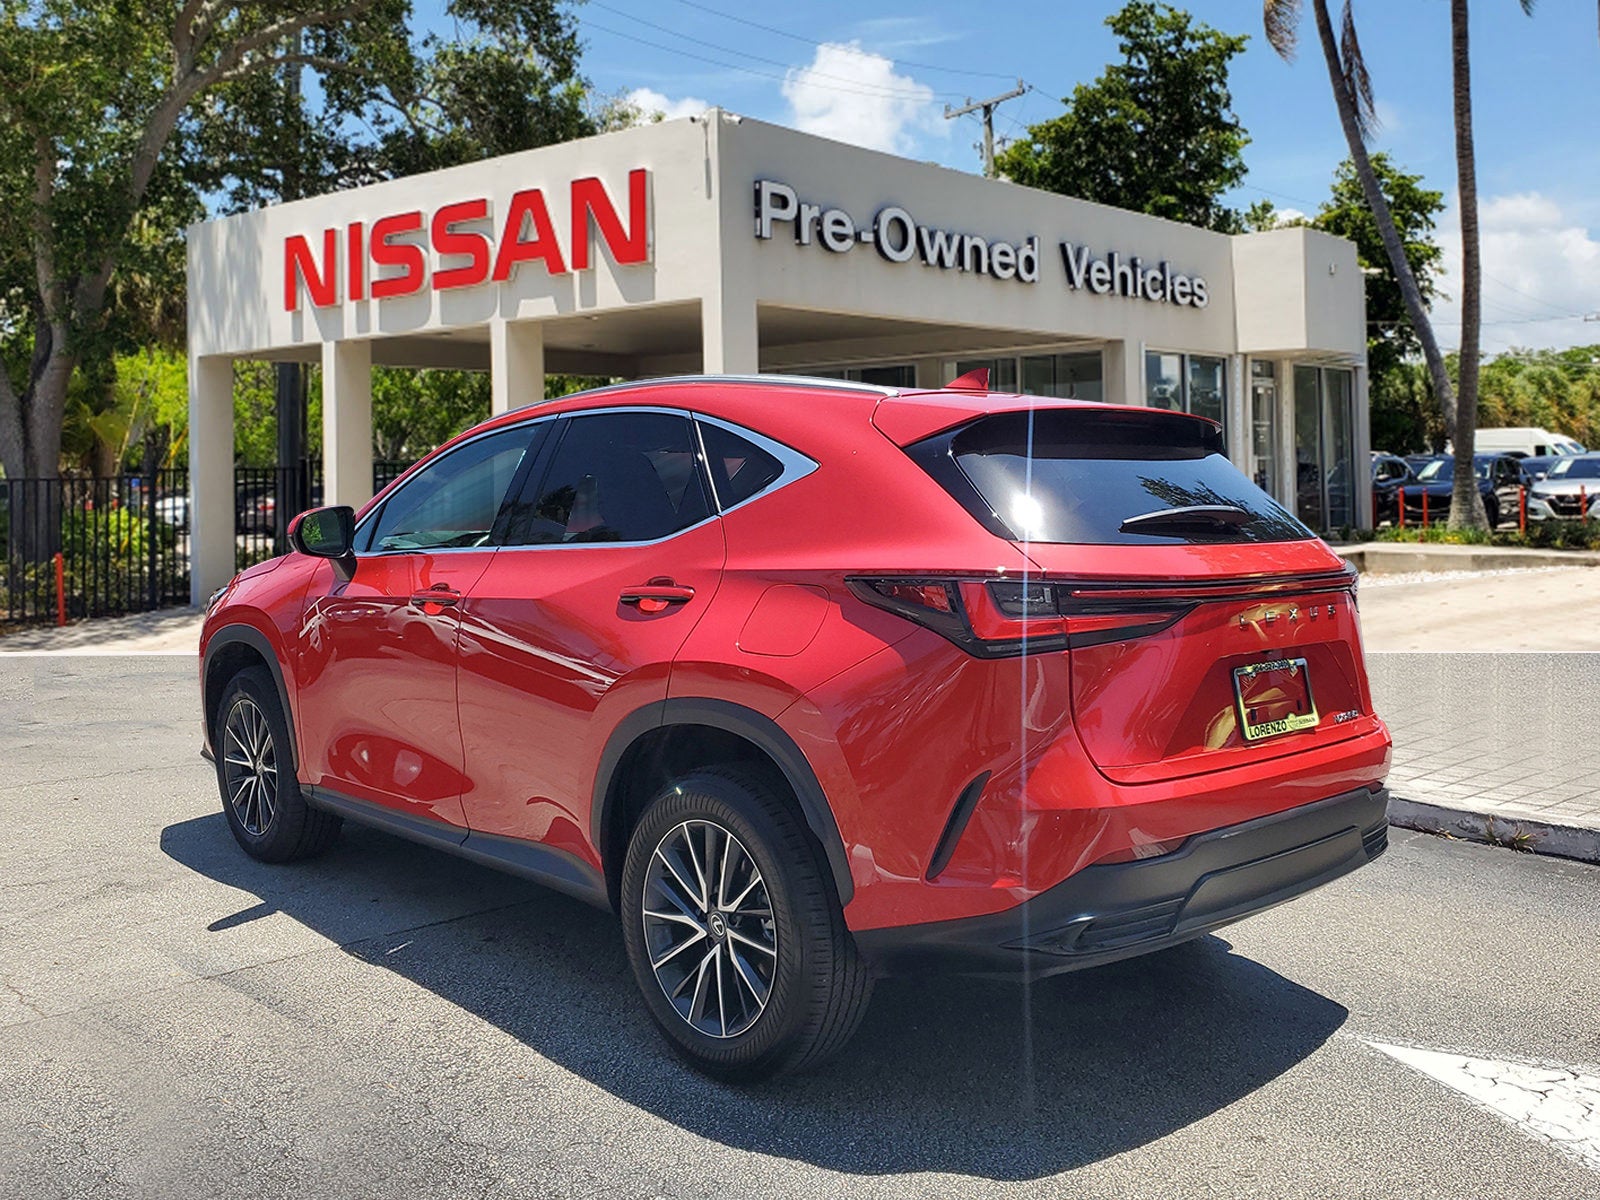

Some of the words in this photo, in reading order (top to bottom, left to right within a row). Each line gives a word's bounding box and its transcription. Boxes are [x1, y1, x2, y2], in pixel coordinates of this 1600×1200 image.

[284, 168, 648, 312] NISSAN
[754, 180, 1040, 283] Pre-Owned
[1060, 242, 1209, 308] Vehicles
[1240, 604, 1336, 625] LEXUS
[1249, 720, 1287, 738] LORENZO
